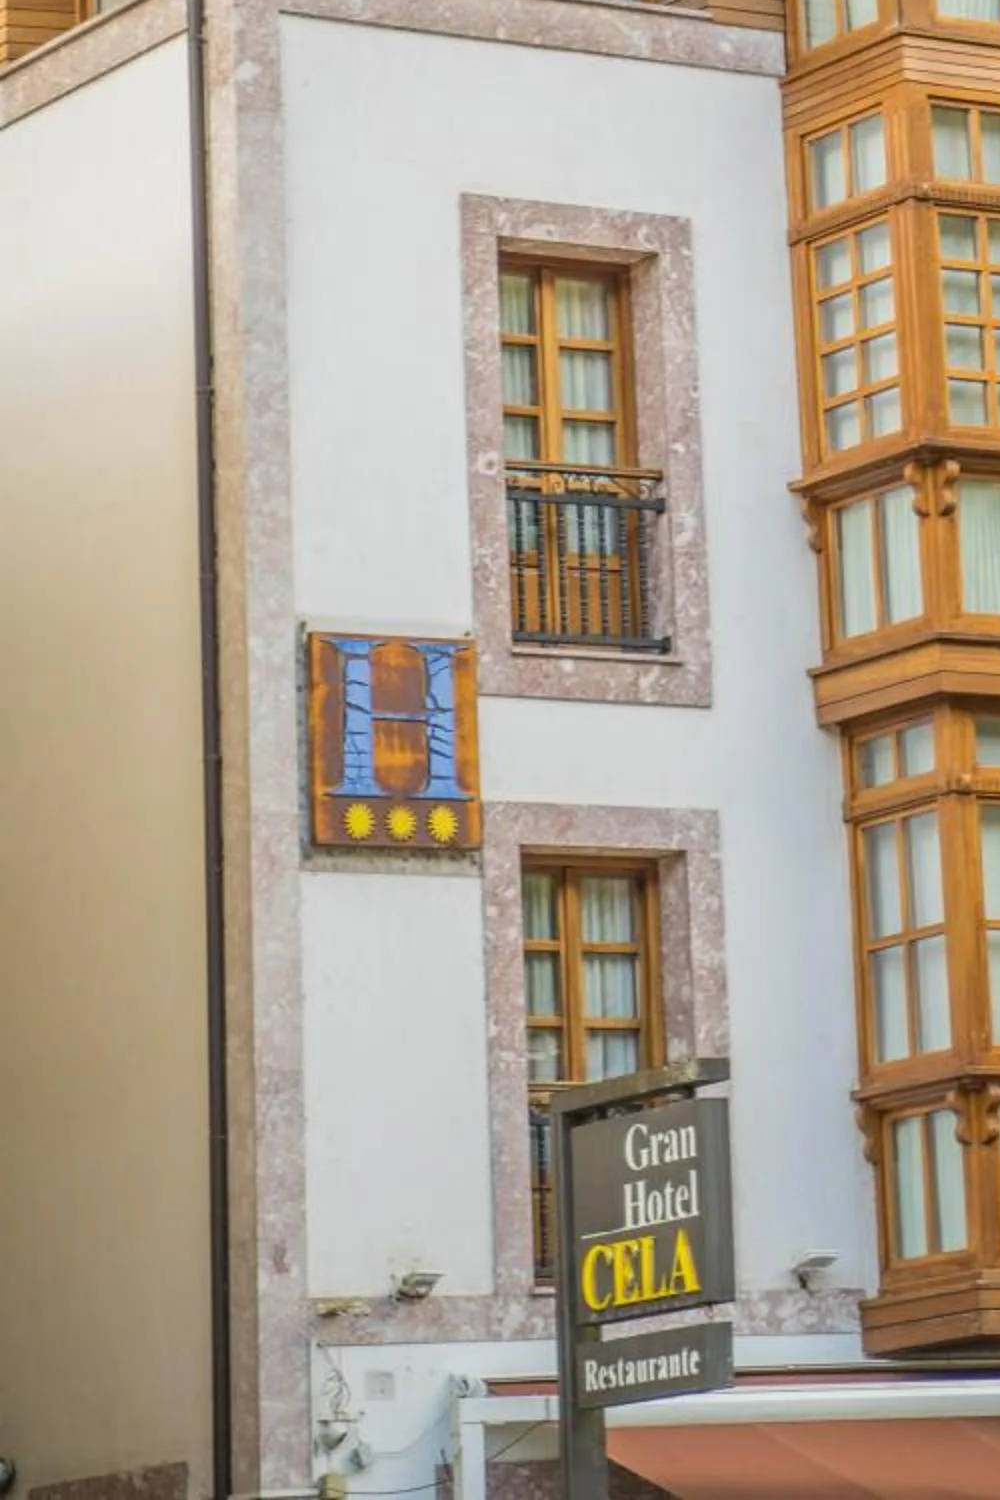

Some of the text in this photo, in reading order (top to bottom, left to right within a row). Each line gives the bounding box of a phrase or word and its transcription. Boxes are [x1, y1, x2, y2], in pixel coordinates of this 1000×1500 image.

[624, 1123, 697, 1171] Gran
[623, 1170, 699, 1230] Hotel
[581, 1227, 701, 1311] CELA
[584, 1348, 700, 1393] Restaurante
